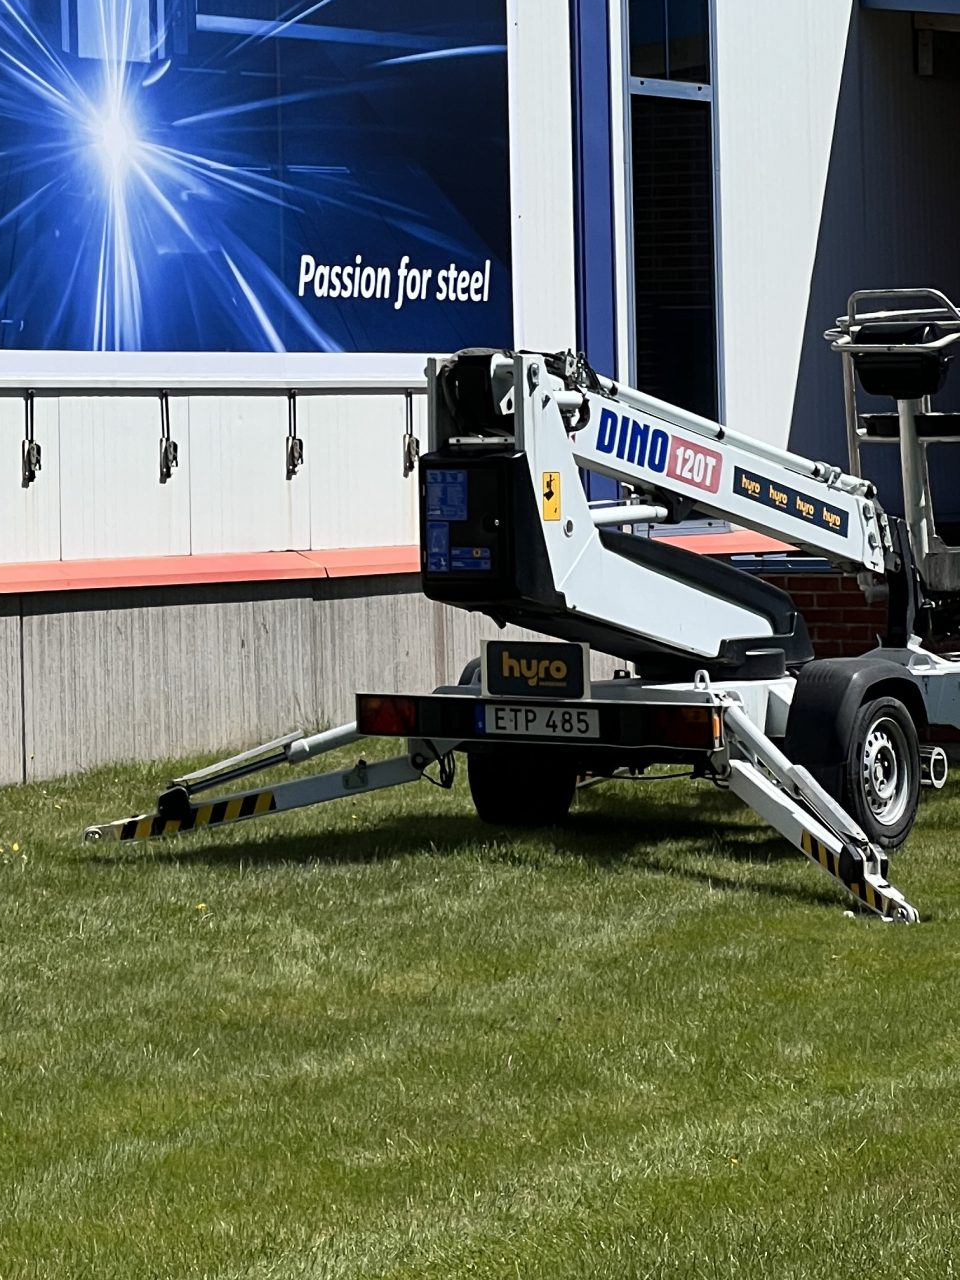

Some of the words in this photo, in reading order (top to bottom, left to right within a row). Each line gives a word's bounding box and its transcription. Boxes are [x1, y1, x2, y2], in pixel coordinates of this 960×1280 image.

[298, 254, 390, 299] Passion
[394, 255, 432, 310] for
[436, 259, 491, 302] steel
[596, 407, 669, 473] DINO
[676, 446, 717, 487] 120T
[741, 474, 760, 494] hyro
[769, 485, 788, 505] hyro
[796, 496, 814, 516] hyro
[823, 507, 841, 526] hyro
[502, 651, 568, 686] hyro
[494, 707, 537, 731] ETP
[545, 710, 589, 734] 485
